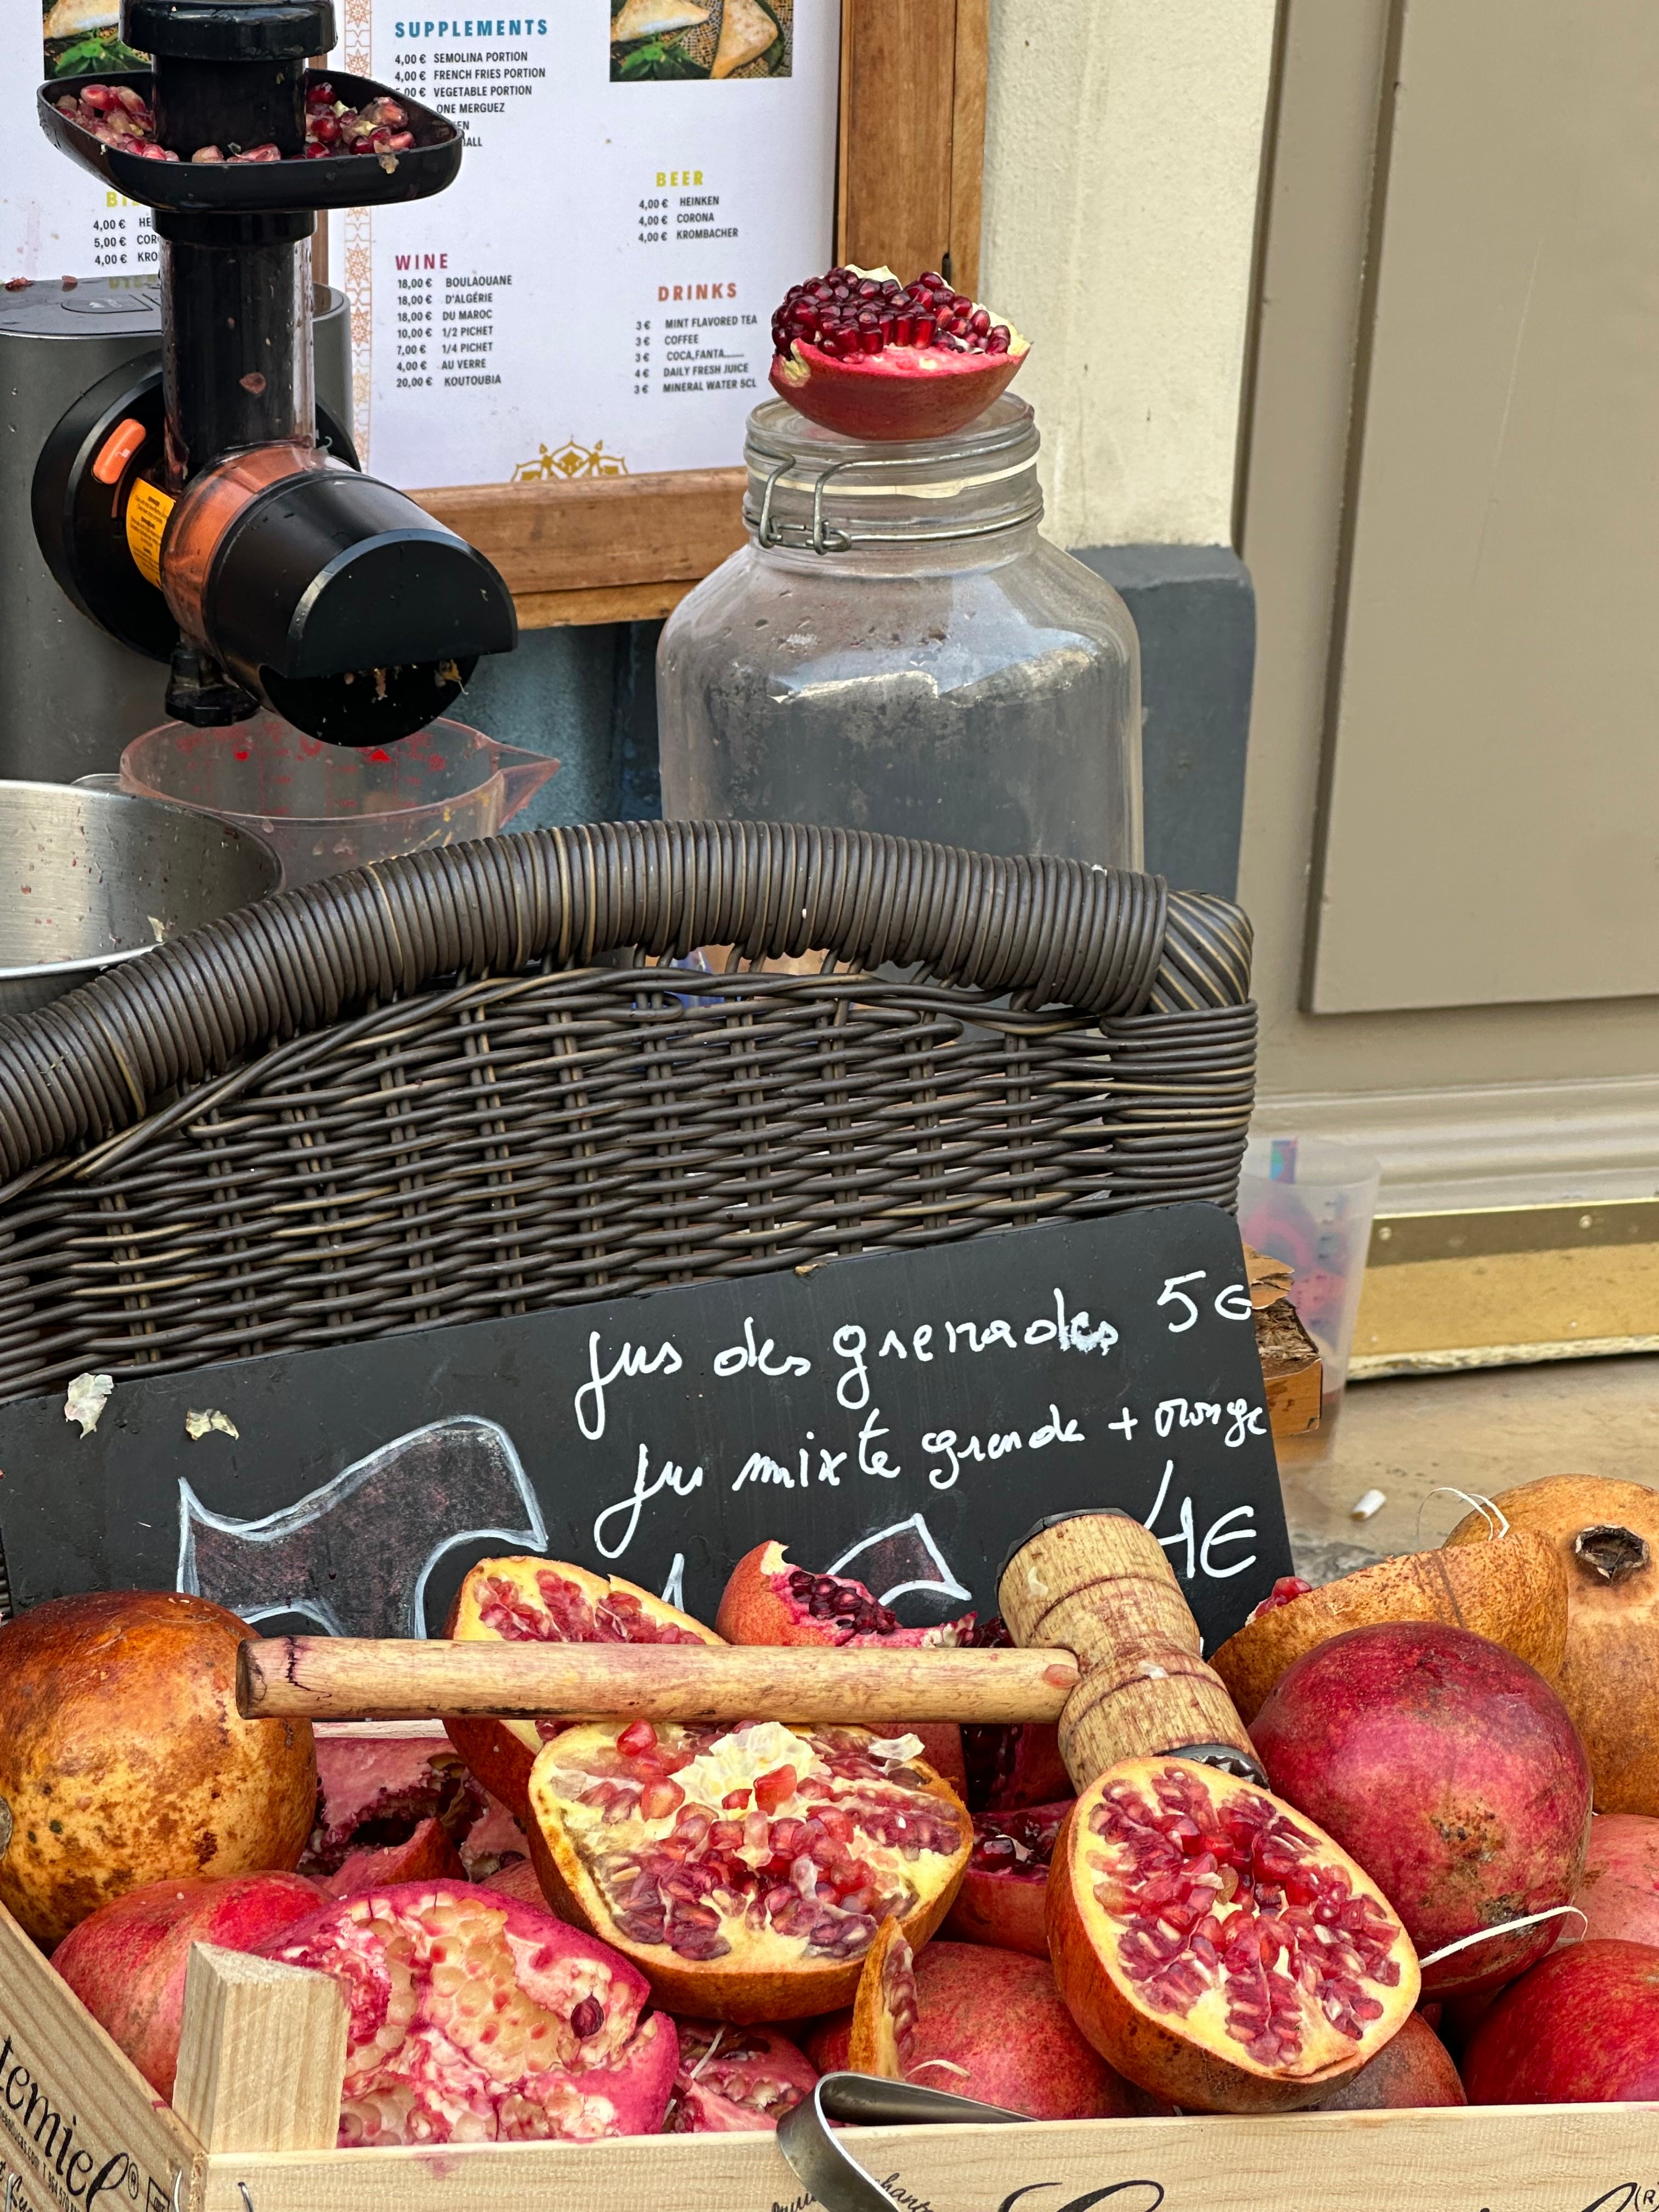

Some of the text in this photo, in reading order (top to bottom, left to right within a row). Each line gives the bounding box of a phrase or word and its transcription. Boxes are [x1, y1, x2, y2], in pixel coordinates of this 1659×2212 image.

[394, 19, 548, 38] SUPPLEMENTS
[395, 51, 528, 66] 4,00 € SEMOLINA PORTION
[395, 67, 545, 83] 4,00 € FRENCH FRIES PORTION
[419, 87, 426, 97] €
[433, 86, 487, 97] VEGETABLE
[490, 85, 532, 96] PORTION
[436, 103, 505, 114] ONE MERGUEZ
[656, 170, 704, 187] BEER
[639, 196, 720, 210] 4,00 € HEINKEN
[93, 219, 116, 232] 4,00
[119, 219, 126, 229] €
[639, 212, 714, 227] 4,00 € CORONA
[94, 234, 159, 249] 5,00 € COR
[638, 228, 738, 244] 4,00 € KROMBACHER
[94, 255, 117, 267] 4,00
[120, 254, 127, 264] €
[395, 253, 448, 271] WINE
[398, 275, 512, 290] 18,00 € BOULAOUANE
[398, 291, 493, 307] 18,00 € D'ALGÉRIE
[658, 283, 737, 302] DRINKS
[397, 309, 493, 323] 18,00 € DU MAROC
[636, 314, 758, 330] 3 € MINT FLAVORED TEA
[397, 325, 493, 340] 10,00 € 1/2 PICHET
[635, 334, 698, 347] 3 € COFFEE
[397, 342, 493, 356] 7,00 € 1/4 PICHET
[396, 358, 486, 373] 4,00 € AU VERRE
[635, 353, 641, 363] 3
[643, 353, 650, 362] €
[635, 363, 748, 378] 4 € DAILY FRESH JUICE
[396, 374, 501, 388] 20,00 € KOUTOUBIA
[634, 385, 640, 394] 3
[642, 385, 648, 394] €
[663, 381, 703, 393] MINERAL
[706, 379, 738, 391] WATER
[574, 1330, 682, 1440] jus
[714, 1316, 811, 1376] des
[833, 1288, 1119, 1409] grenades
[731, 1408, 901, 1491] mixte
